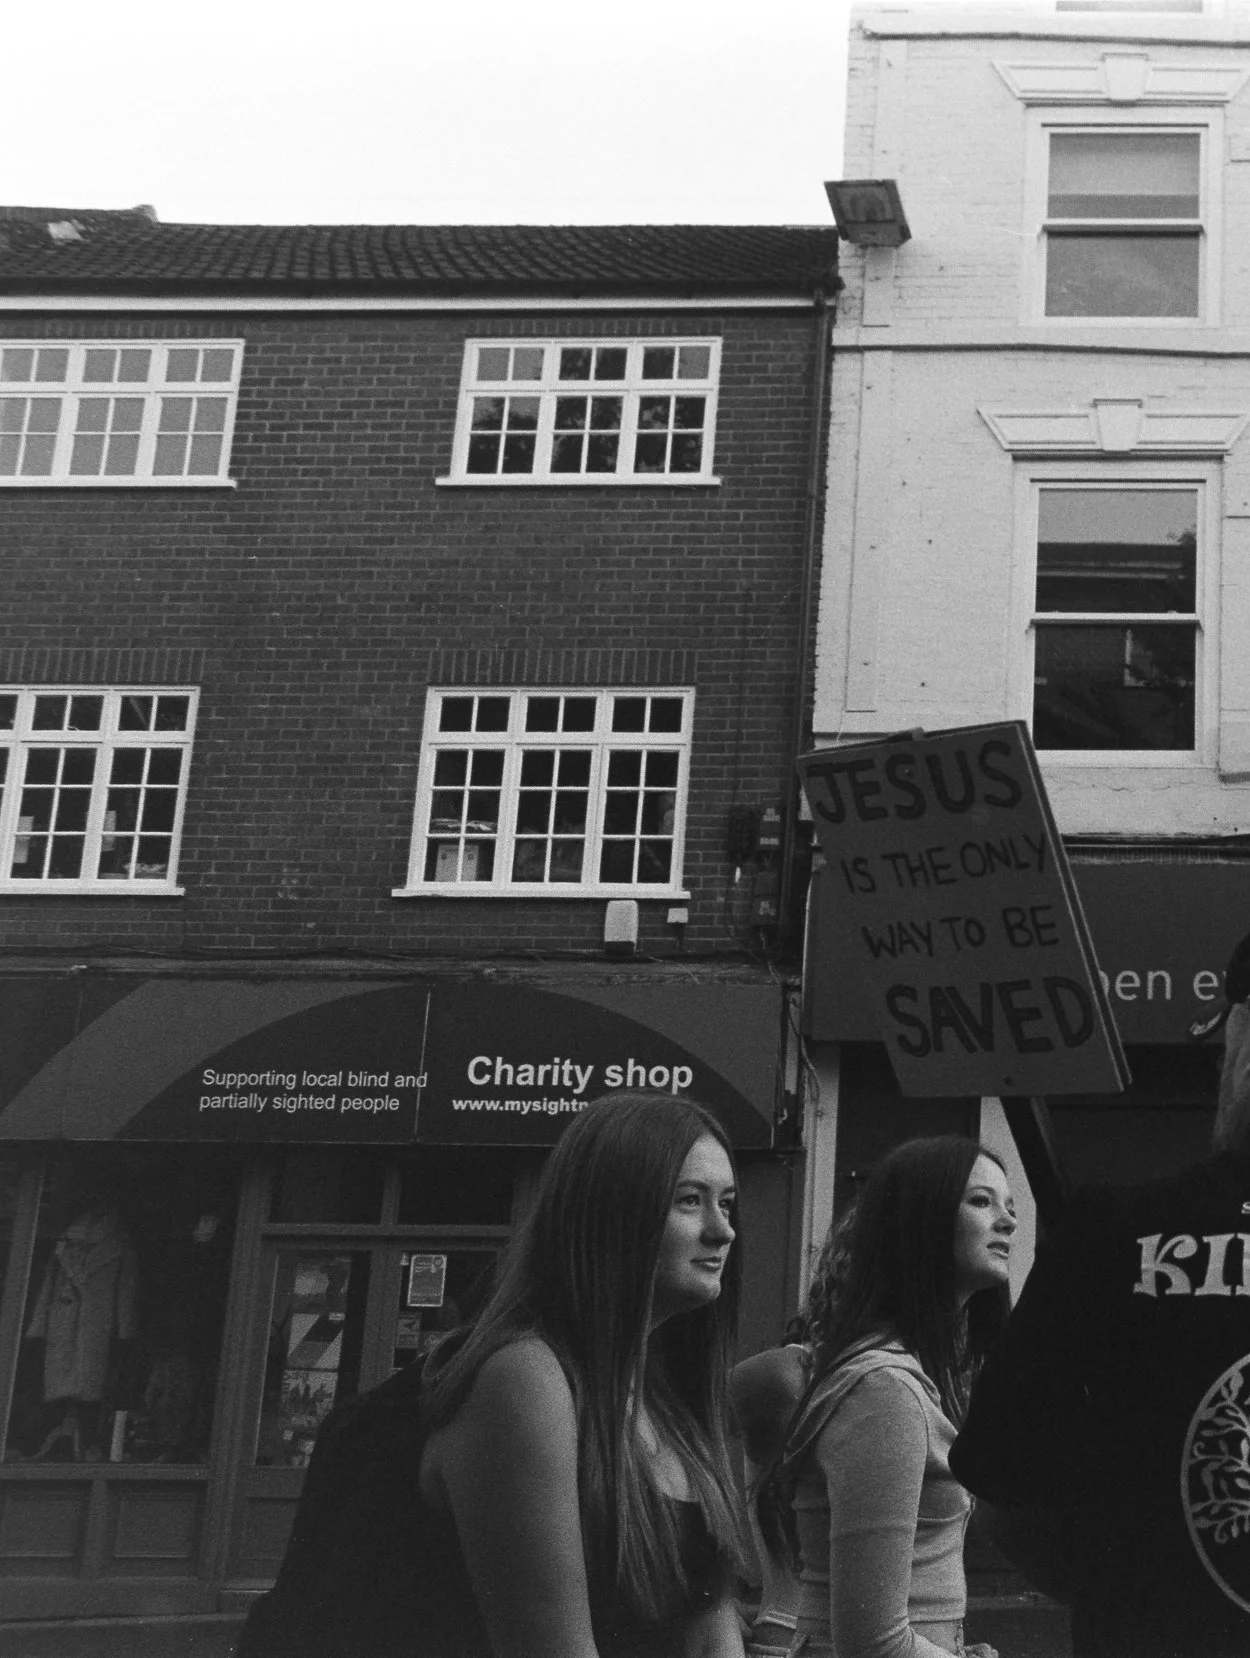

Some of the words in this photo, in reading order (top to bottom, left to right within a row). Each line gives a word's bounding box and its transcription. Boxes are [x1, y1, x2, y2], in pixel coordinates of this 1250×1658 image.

[804, 740, 1023, 825] JESUS
[840, 857, 876, 894] IS
[882, 846, 957, 888] THE
[960, 834, 1048, 878] ONLY
[861, 920, 934, 958] WAY
[938, 916, 986, 951] TO
[1002, 904, 1060, 948] BE
[885, 976, 1096, 1058] SAVED
[202, 1068, 297, 1091] Supporting
[301, 1070, 344, 1088] local
[347, 1070, 390, 1088] blind
[393, 1071, 429, 1089] and
[467, 1056, 595, 1095] Charity
[604, 1057, 694, 1095] shop
[198, 1092, 269, 1113] partially
[272, 1092, 337, 1114] sighted
[340, 1095, 400, 1114] people
